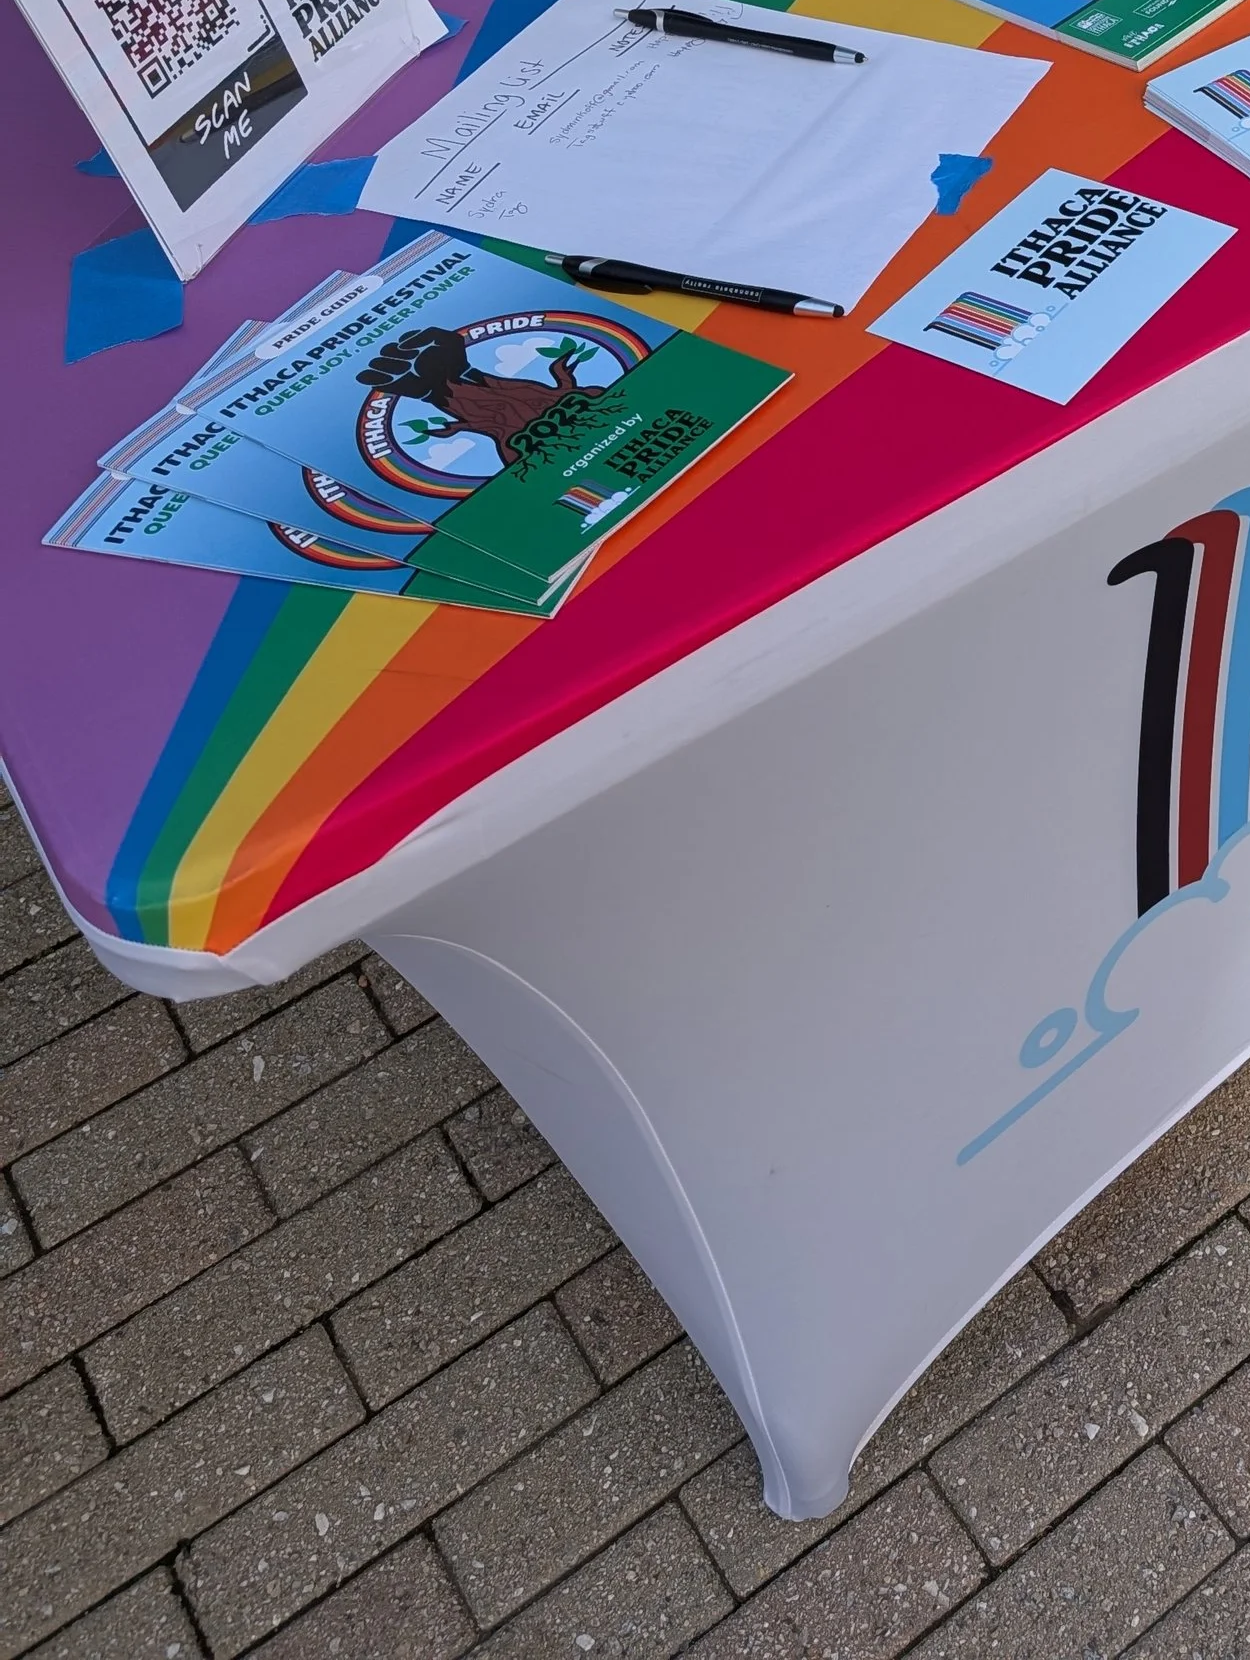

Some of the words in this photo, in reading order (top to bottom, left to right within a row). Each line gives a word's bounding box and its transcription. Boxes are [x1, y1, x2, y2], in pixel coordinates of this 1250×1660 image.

[194, 71, 251, 144] SCAN
[223, 108, 252, 159] ME
[421, 91, 526, 160] Mailing
[500, 59, 545, 89] List
[513, 91, 566, 130] EMAIL
[435, 161, 482, 205] NAME
[990, 186, 1107, 276] ITHACA
[1020, 189, 1141, 289] PRIDE
[1051, 201, 1168, 301] ALLIANCE
[219, 359, 313, 418] ITHACA
[305, 312, 378, 360] PRIDE
[371, 252, 471, 315] FESTIVAL
[272, 316, 321, 349] PRIDE
[320, 285, 368, 316] GUIDE
[517, 395, 586, 454] 2025
[562, 425, 626, 476] organized
[621, 412, 642, 426] by
